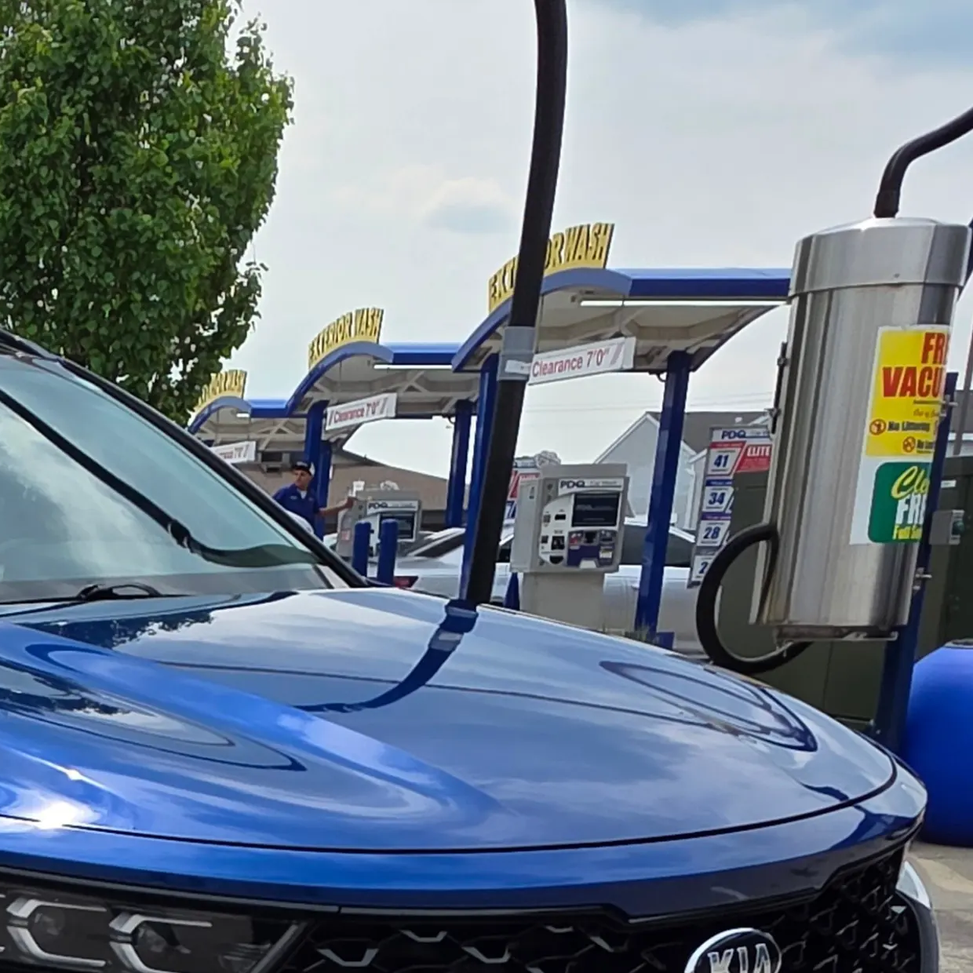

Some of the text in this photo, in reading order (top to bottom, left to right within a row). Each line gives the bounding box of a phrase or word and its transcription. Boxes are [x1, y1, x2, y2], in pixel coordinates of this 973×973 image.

[565, 222, 614, 266] WASH
[308, 307, 384, 360] EXTERIOR WASH
[532, 356, 583, 378] Clearance
[882, 366, 945, 398] VACU
[721, 430, 746, 440] PDQ
[714, 454, 729, 468] 41
[708, 492, 726, 506] 34
[703, 526, 721, 540] 28
